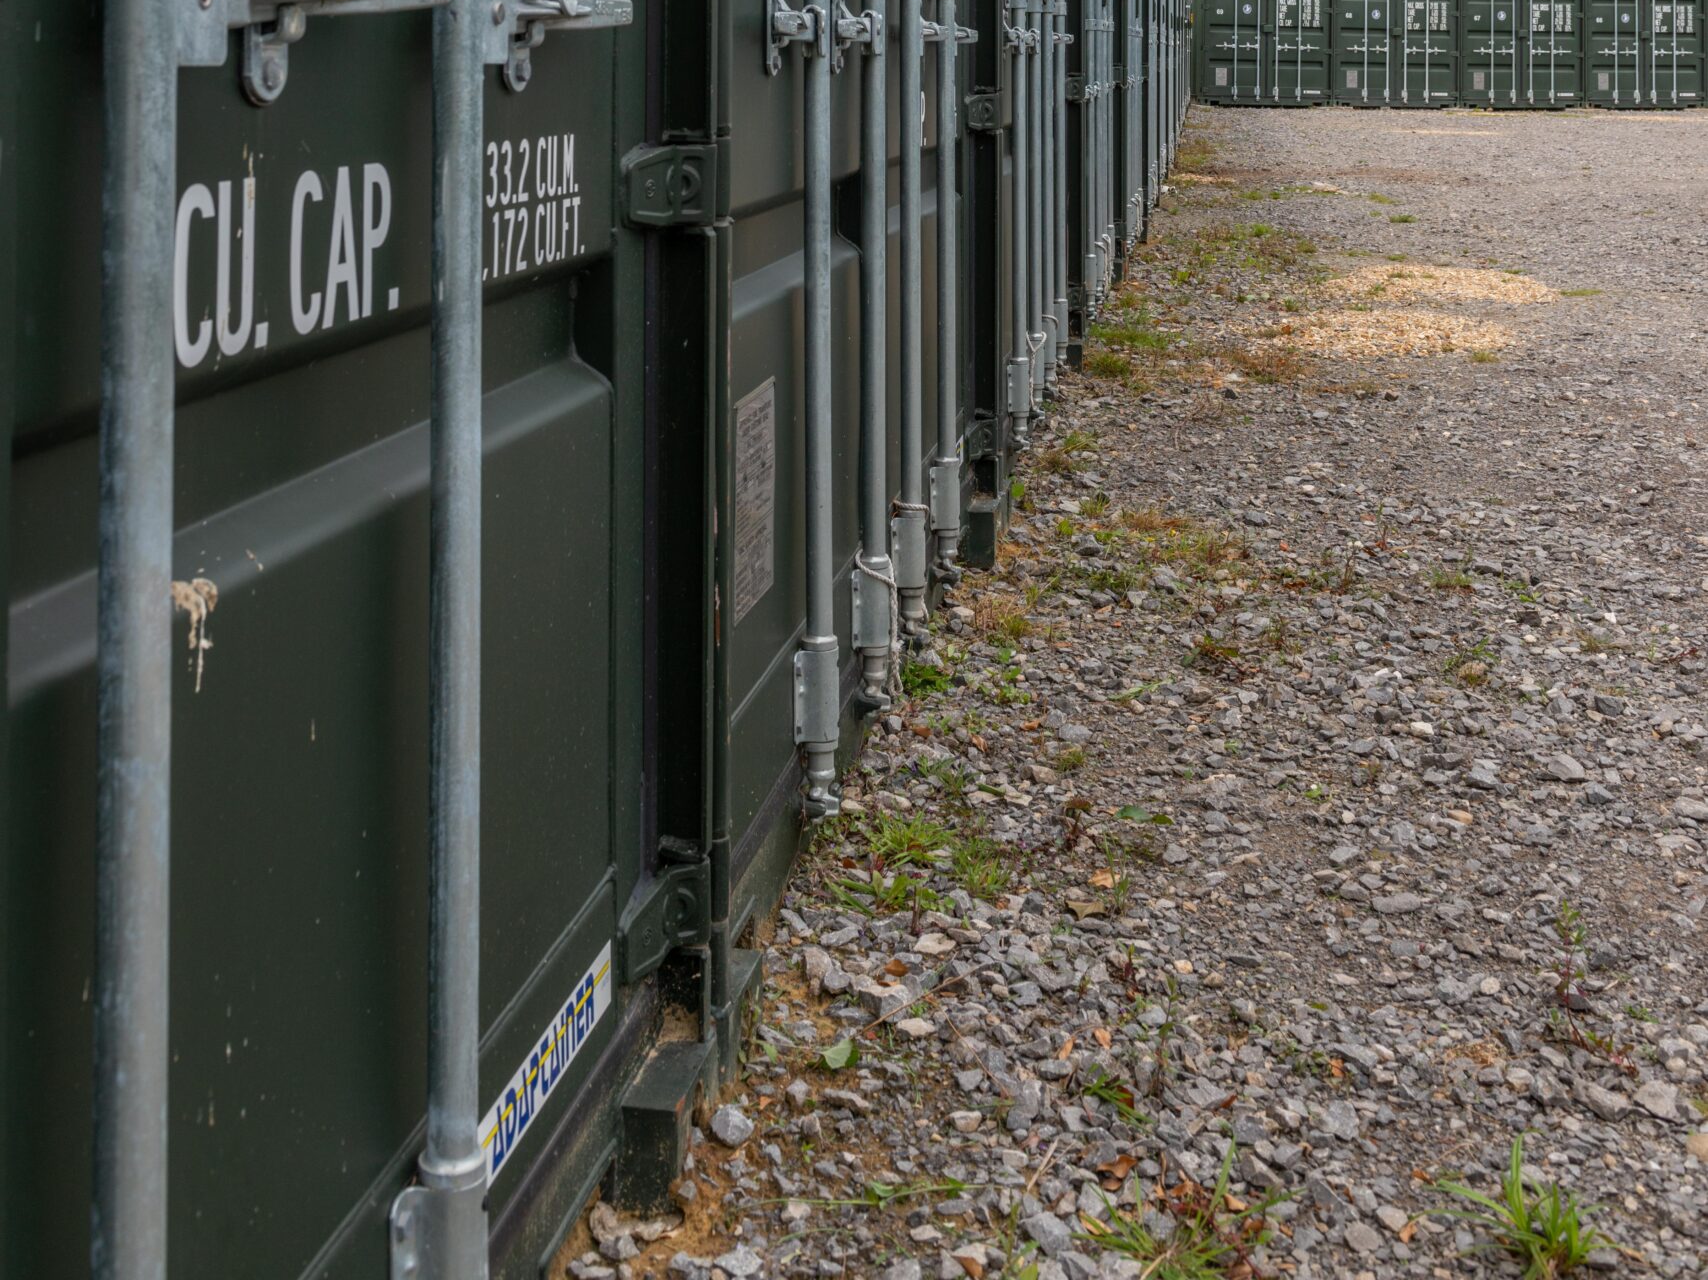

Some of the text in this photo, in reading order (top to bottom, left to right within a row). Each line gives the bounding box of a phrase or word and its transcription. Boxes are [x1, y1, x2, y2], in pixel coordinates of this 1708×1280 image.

[536, 133, 579, 198] CU.M.
[173, 162, 399, 368] CU. CAP.
[535, 196, 585, 265] CU.FT.
